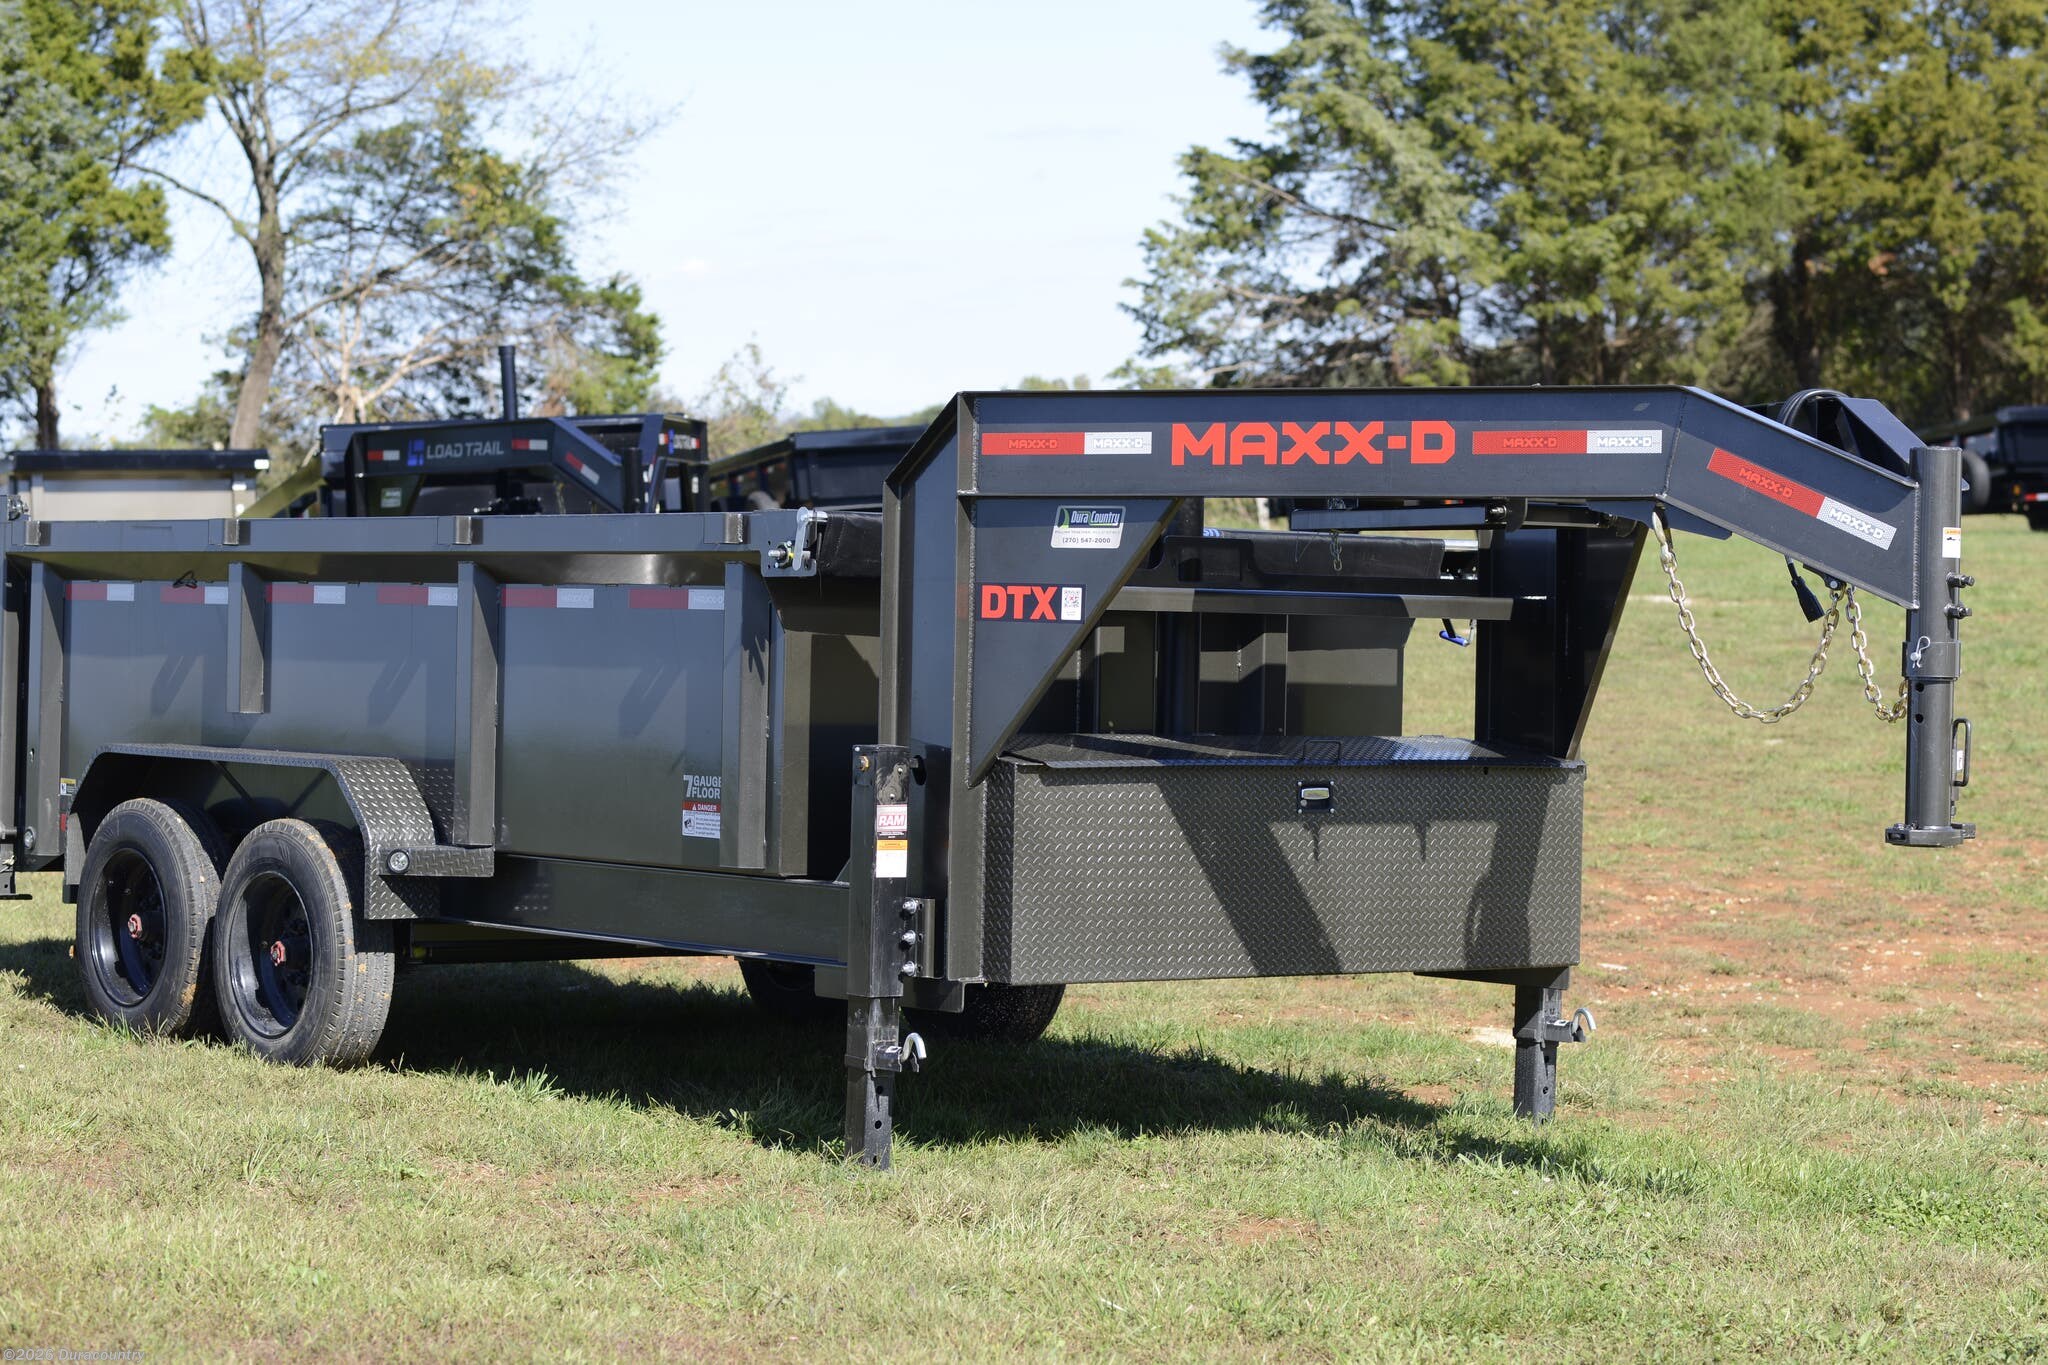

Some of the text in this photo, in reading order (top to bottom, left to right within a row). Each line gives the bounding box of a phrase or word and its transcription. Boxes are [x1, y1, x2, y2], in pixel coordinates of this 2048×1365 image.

[1008, 439, 1058, 449] MAXX-D
[1093, 438, 1144, 449] MAXX-D
[1171, 421, 1456, 465] MAXX-D
[1503, 437, 1558, 448] MAXX-D
[1597, 436, 1653, 448] MAXX-D
[426, 441, 504, 459] LOAD TRAIL
[1738, 467, 1793, 498] MAXX-D
[1071, 510, 1120, 525] Dura Country
[1828, 507, 1885, 539] MAXX-D
[981, 585, 1058, 620] DTX
[683, 774, 693, 798] 7
[692, 786, 721, 799] FLOOR
[697, 803, 718, 812] DANGER
[878, 814, 905, 827] RAM
